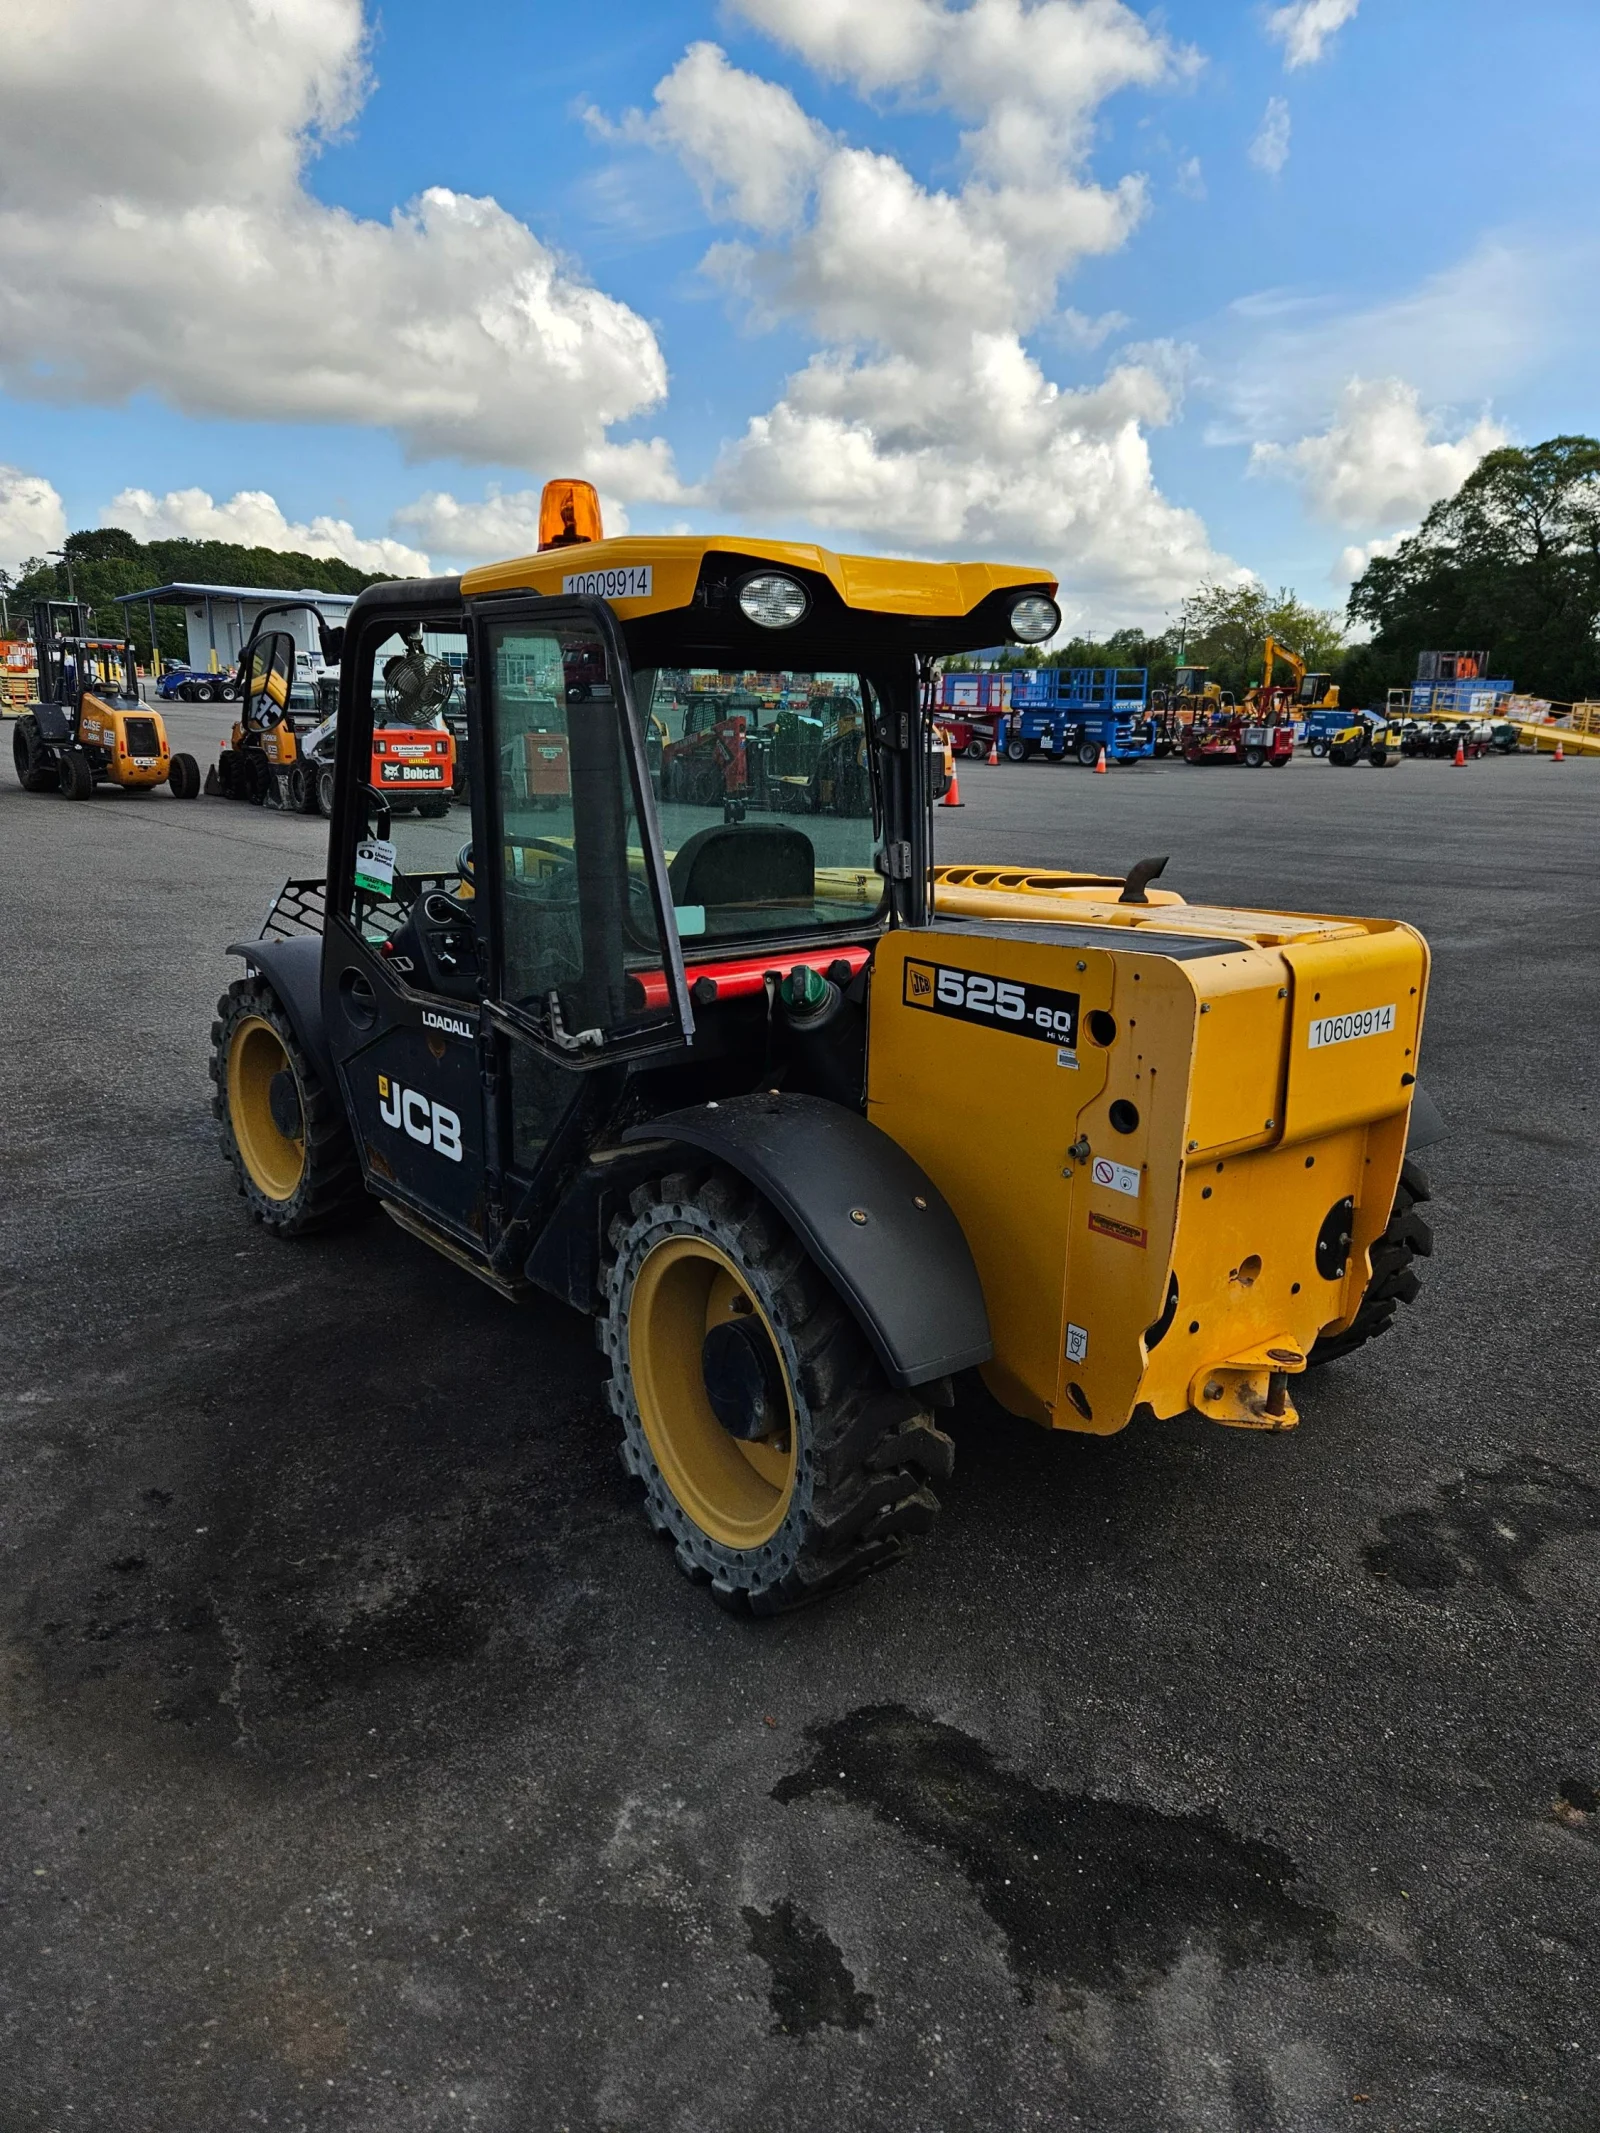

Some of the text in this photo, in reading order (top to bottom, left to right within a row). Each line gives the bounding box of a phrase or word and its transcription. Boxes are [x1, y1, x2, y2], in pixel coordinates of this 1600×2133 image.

[568, 568, 648, 597] 10609914
[82, 719, 101, 732] CASE
[402, 766, 440, 780] Bobcat
[375, 852, 393, 861] United
[912, 972, 932, 995] JCB
[936, 968, 1072, 1032] 525-60
[421, 1010, 474, 1039] LOADALL
[1046, 1031, 1071, 1043] Hi Viz
[1315, 1007, 1391, 1045] 10609914
[379, 1080, 464, 1162] JCB
